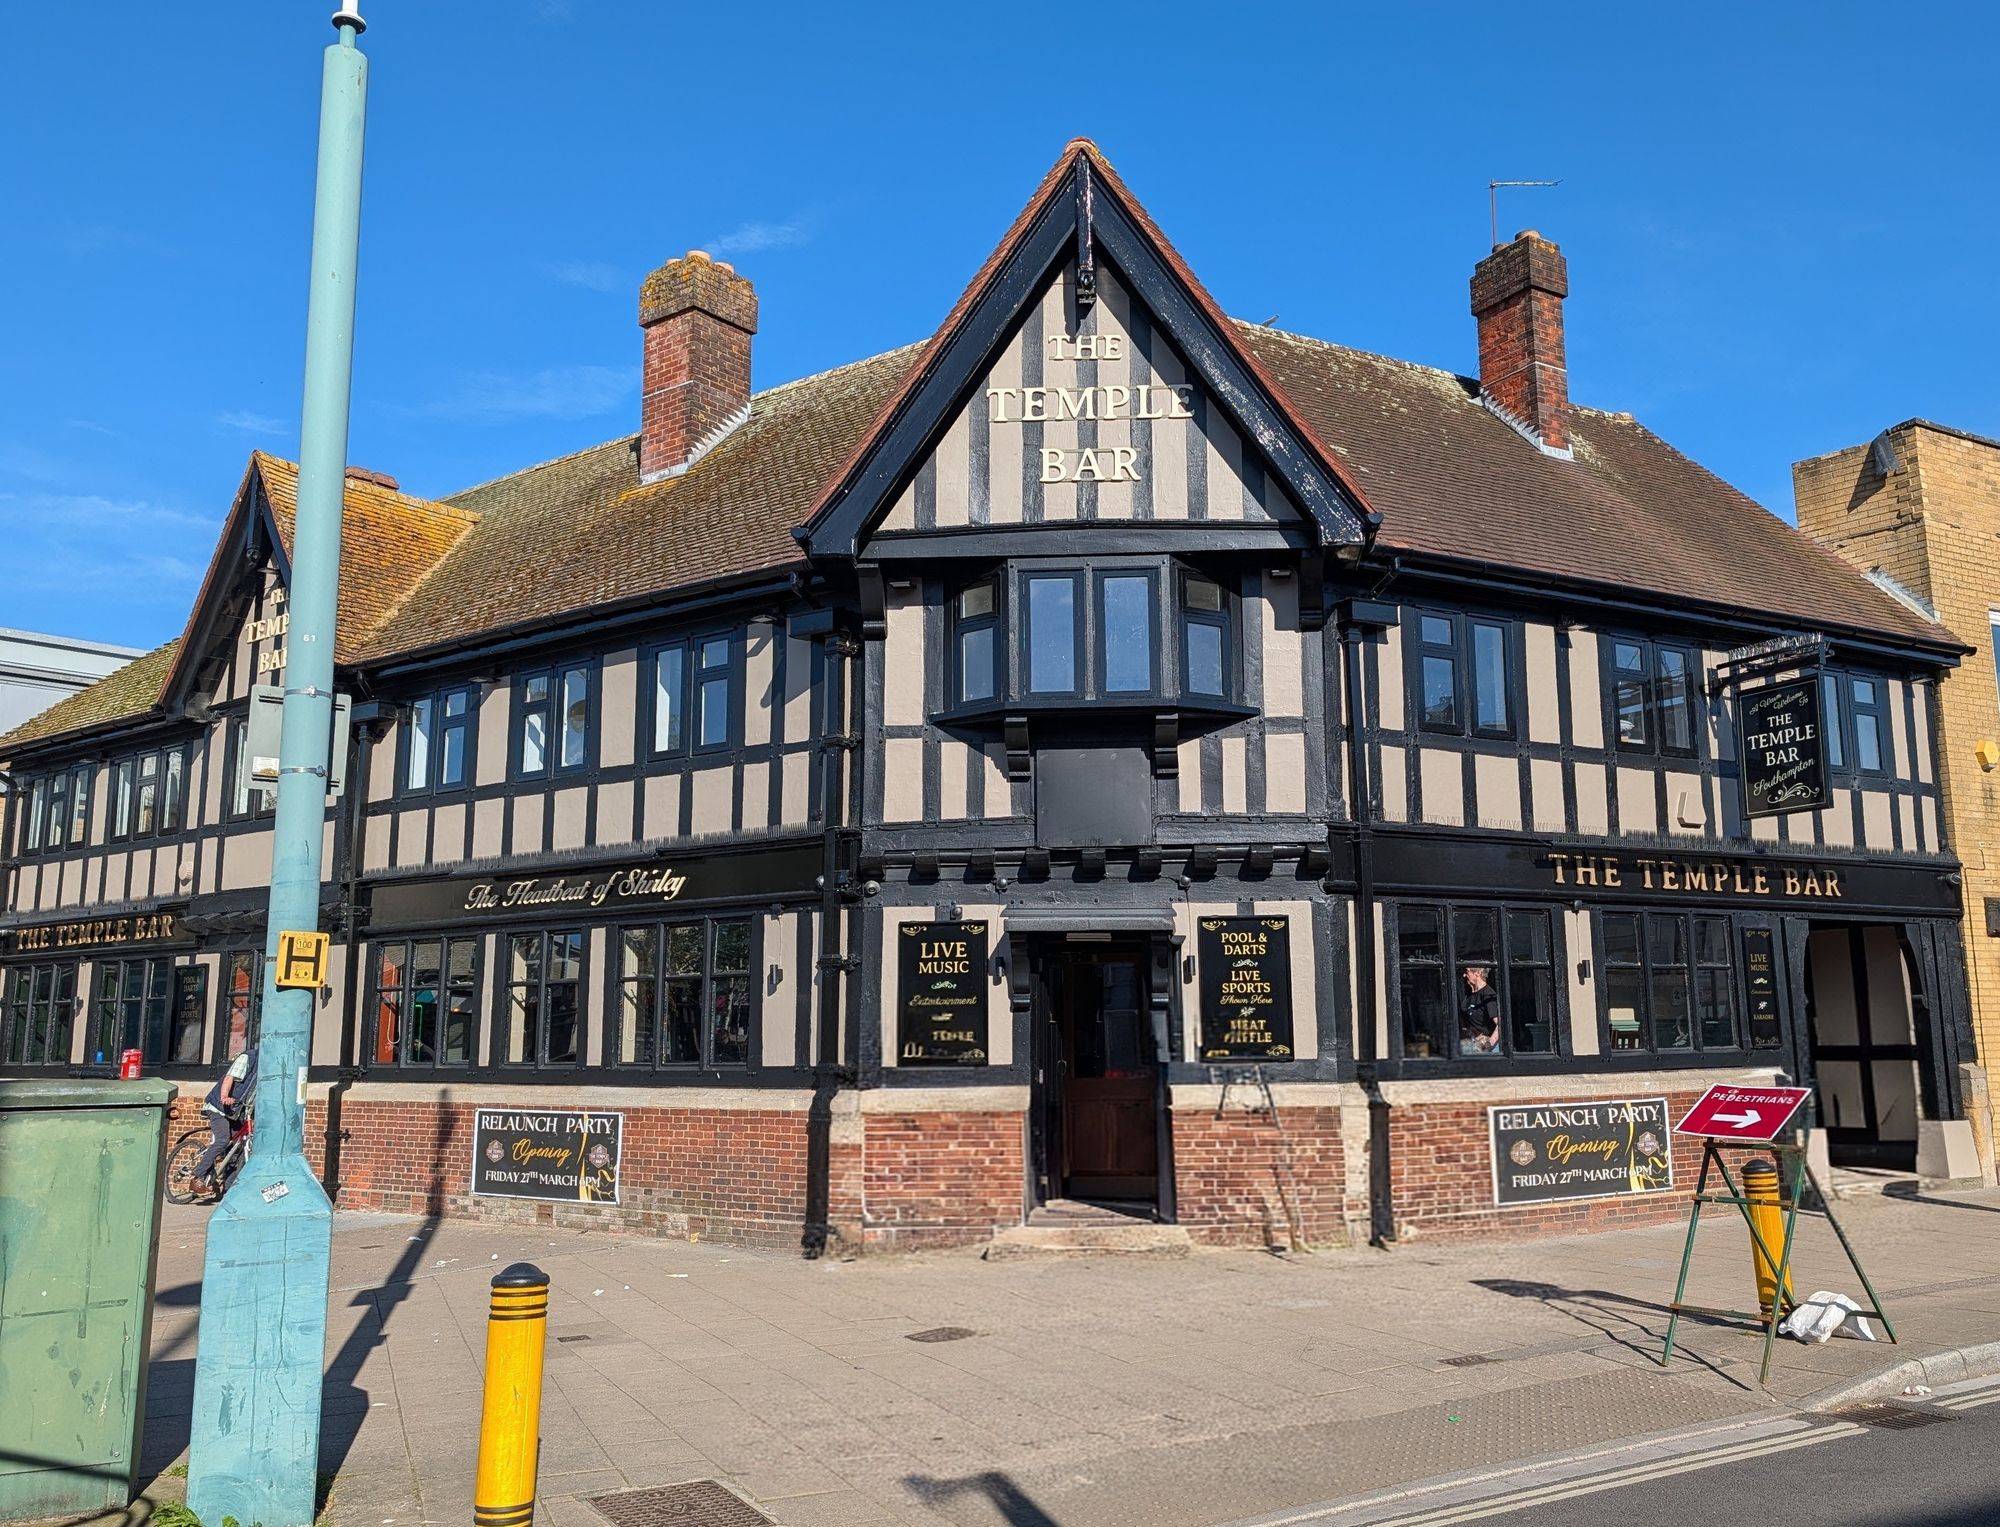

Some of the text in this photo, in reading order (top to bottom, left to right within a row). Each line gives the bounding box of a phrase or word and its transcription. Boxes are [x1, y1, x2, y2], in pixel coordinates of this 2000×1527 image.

[1048, 334, 1122, 360] THE
[986, 384, 1196, 423] TEMPLE
[1039, 447, 1141, 482] BAR
[270, 588, 287, 606] TH
[245, 613, 290, 644] TEMP
[1767, 713, 1793, 728] THE
[1747, 724, 1816, 750] TEMPLE
[1765, 747, 1800, 767] BAR
[1753, 757, 1816, 796] Southampton
[1548, 854, 1842, 897] THE TEMPLE BAR
[465, 868, 687, 910] The Heartbeat of Shirley
[16, 914, 175, 950] THE TEMPLE BAR
[1221, 932, 1268, 943] POOL &
[299, 940, 312, 949] 100
[921, 942, 967, 959] LIVE
[1224, 944, 1266, 955] DARTS
[284, 936, 322, 981] H
[1750, 953, 1768, 962] LIVE
[919, 961, 970, 974] MUSIC
[1231, 970, 1260, 981] LIVE
[1750, 964, 1769, 972] MUSIC
[1222, 982, 1271, 993] SPORTS
[1220, 993, 1273, 1005] Shown Here
[1711, 1092, 1796, 1105] PEDESTRIANS
[481, 1115, 614, 1134] RELAUNCH PARTY
[1499, 1105, 1660, 1130] RELAUNCH PARTY
[512, 1138, 572, 1167] Opening
[1546, 1134, 1619, 1164] Opening
[485, 1170, 520, 1183] FRIDAY
[520, 1170, 538, 1184] 27TH
[539, 1174, 578, 1187] MARCH
[1512, 1172, 1559, 1188] FRIDAY
[1560, 1168, 1582, 1184] 27TH
[1583, 1167, 1628, 1180] MARCH
